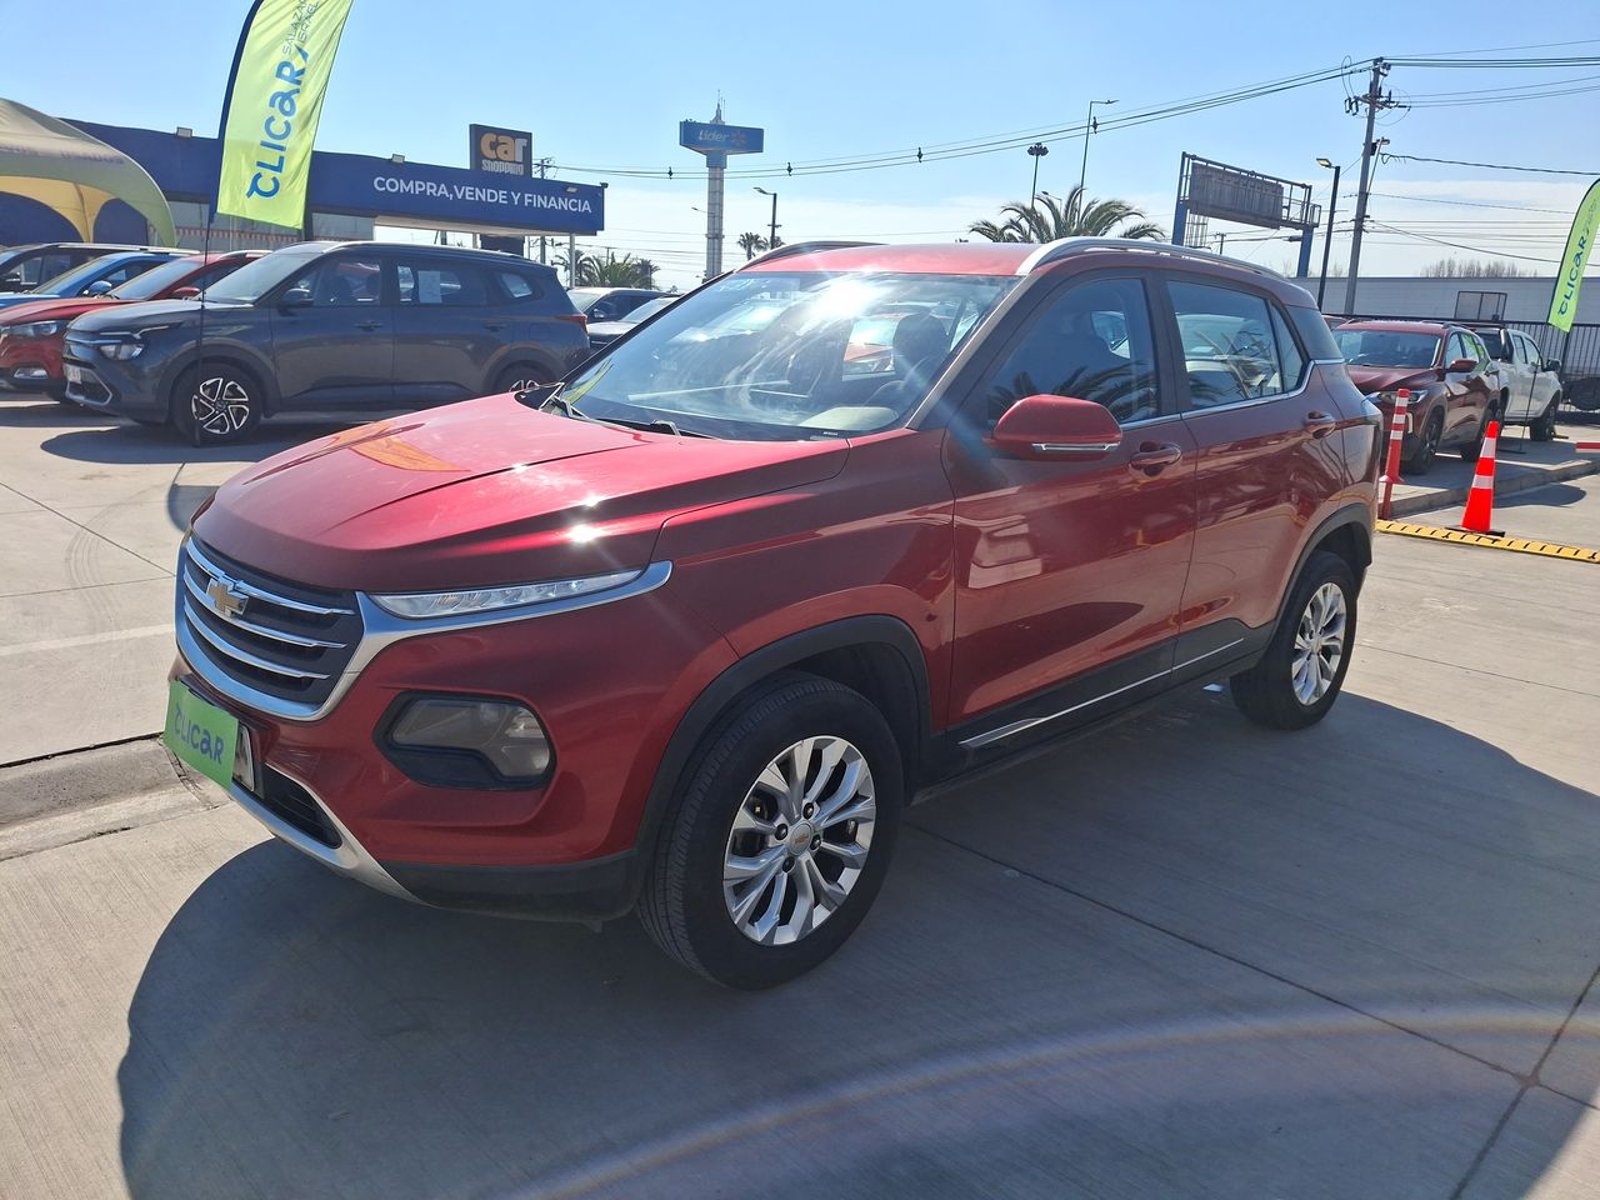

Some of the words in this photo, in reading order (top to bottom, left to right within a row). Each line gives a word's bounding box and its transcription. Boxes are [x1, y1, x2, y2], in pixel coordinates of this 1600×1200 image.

[480, 132, 528, 162] car
[453, 184, 508, 204] VENDE
[510, 191, 521, 206] Y
[524, 193, 592, 213] FINANCIA
